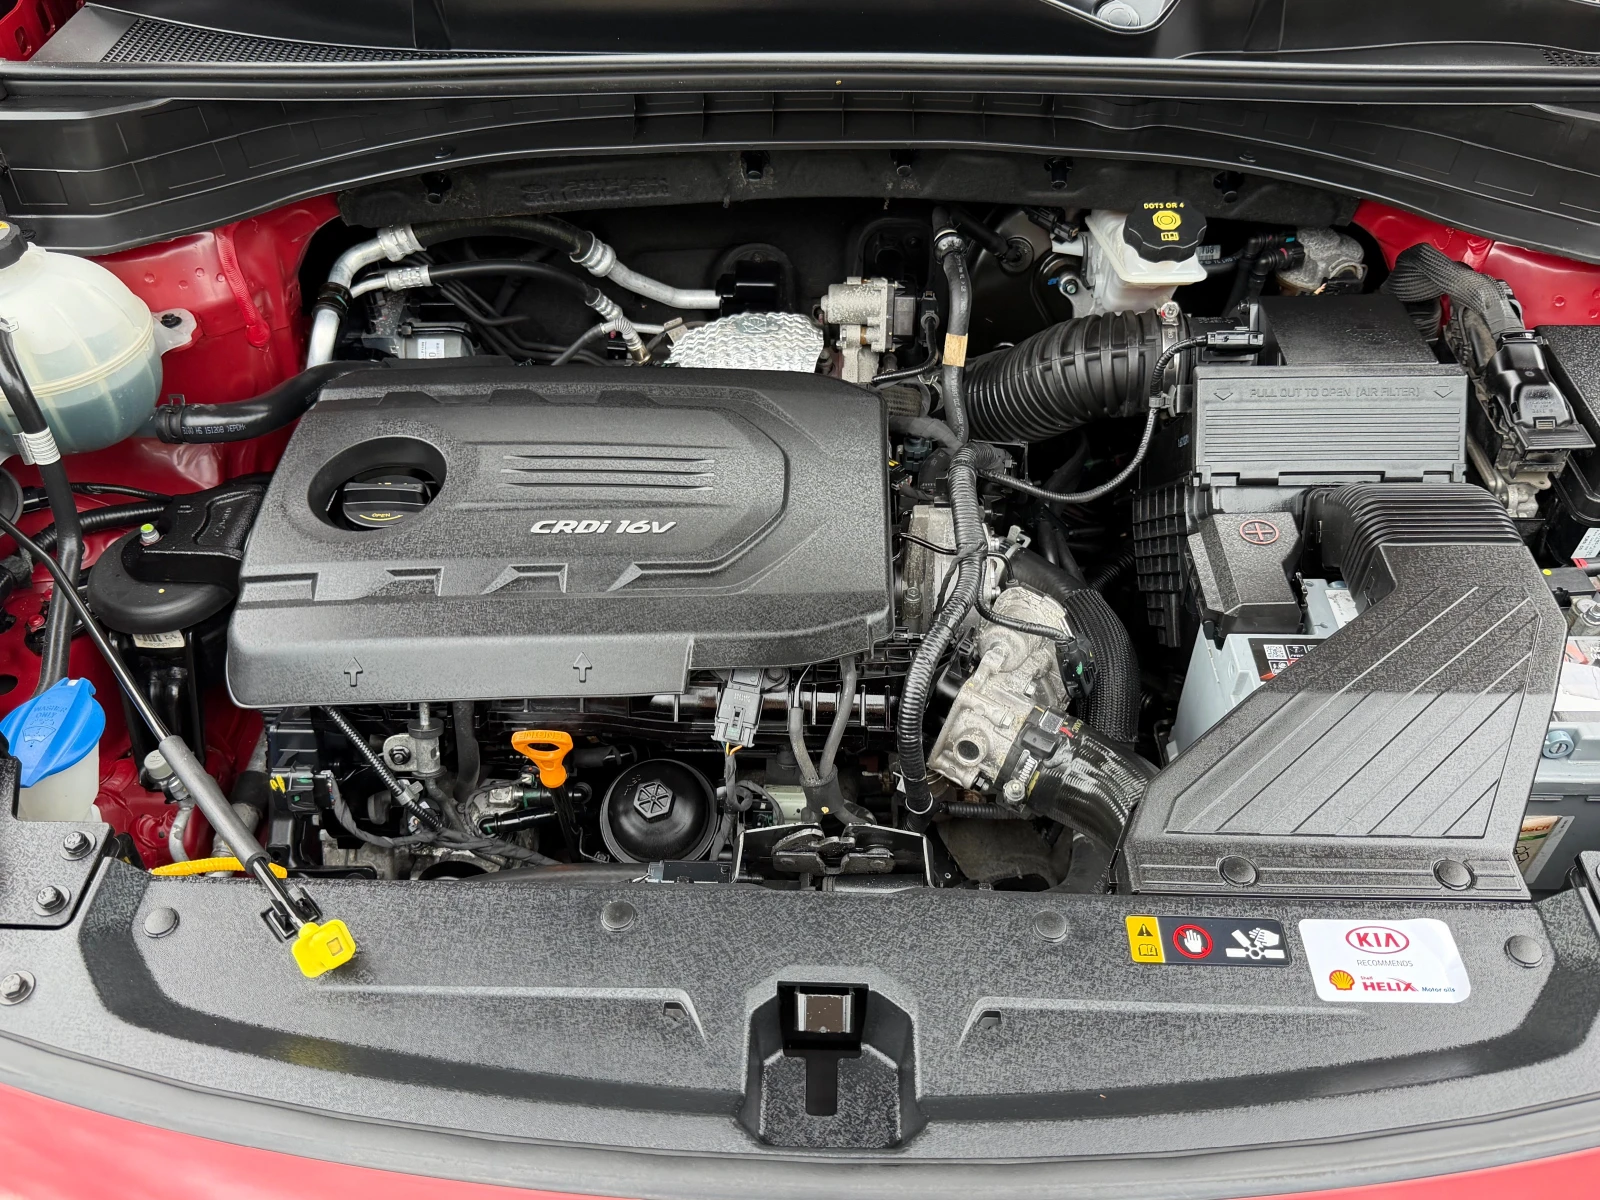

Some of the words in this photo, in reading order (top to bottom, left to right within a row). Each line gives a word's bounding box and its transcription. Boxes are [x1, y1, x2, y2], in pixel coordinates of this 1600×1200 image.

[1251, 387, 1278, 398] PULL
[1279, 387, 1302, 398] OUT
[1304, 387, 1320, 398] TO
[1321, 387, 1351, 398] OPEN
[530, 520, 612, 534] CRDi
[615, 520, 677, 534] 16V
[1355, 932, 1401, 948] KIA
[1356, 959, 1414, 968] RECOMMENDS
[1361, 979, 1418, 992] HELIX
